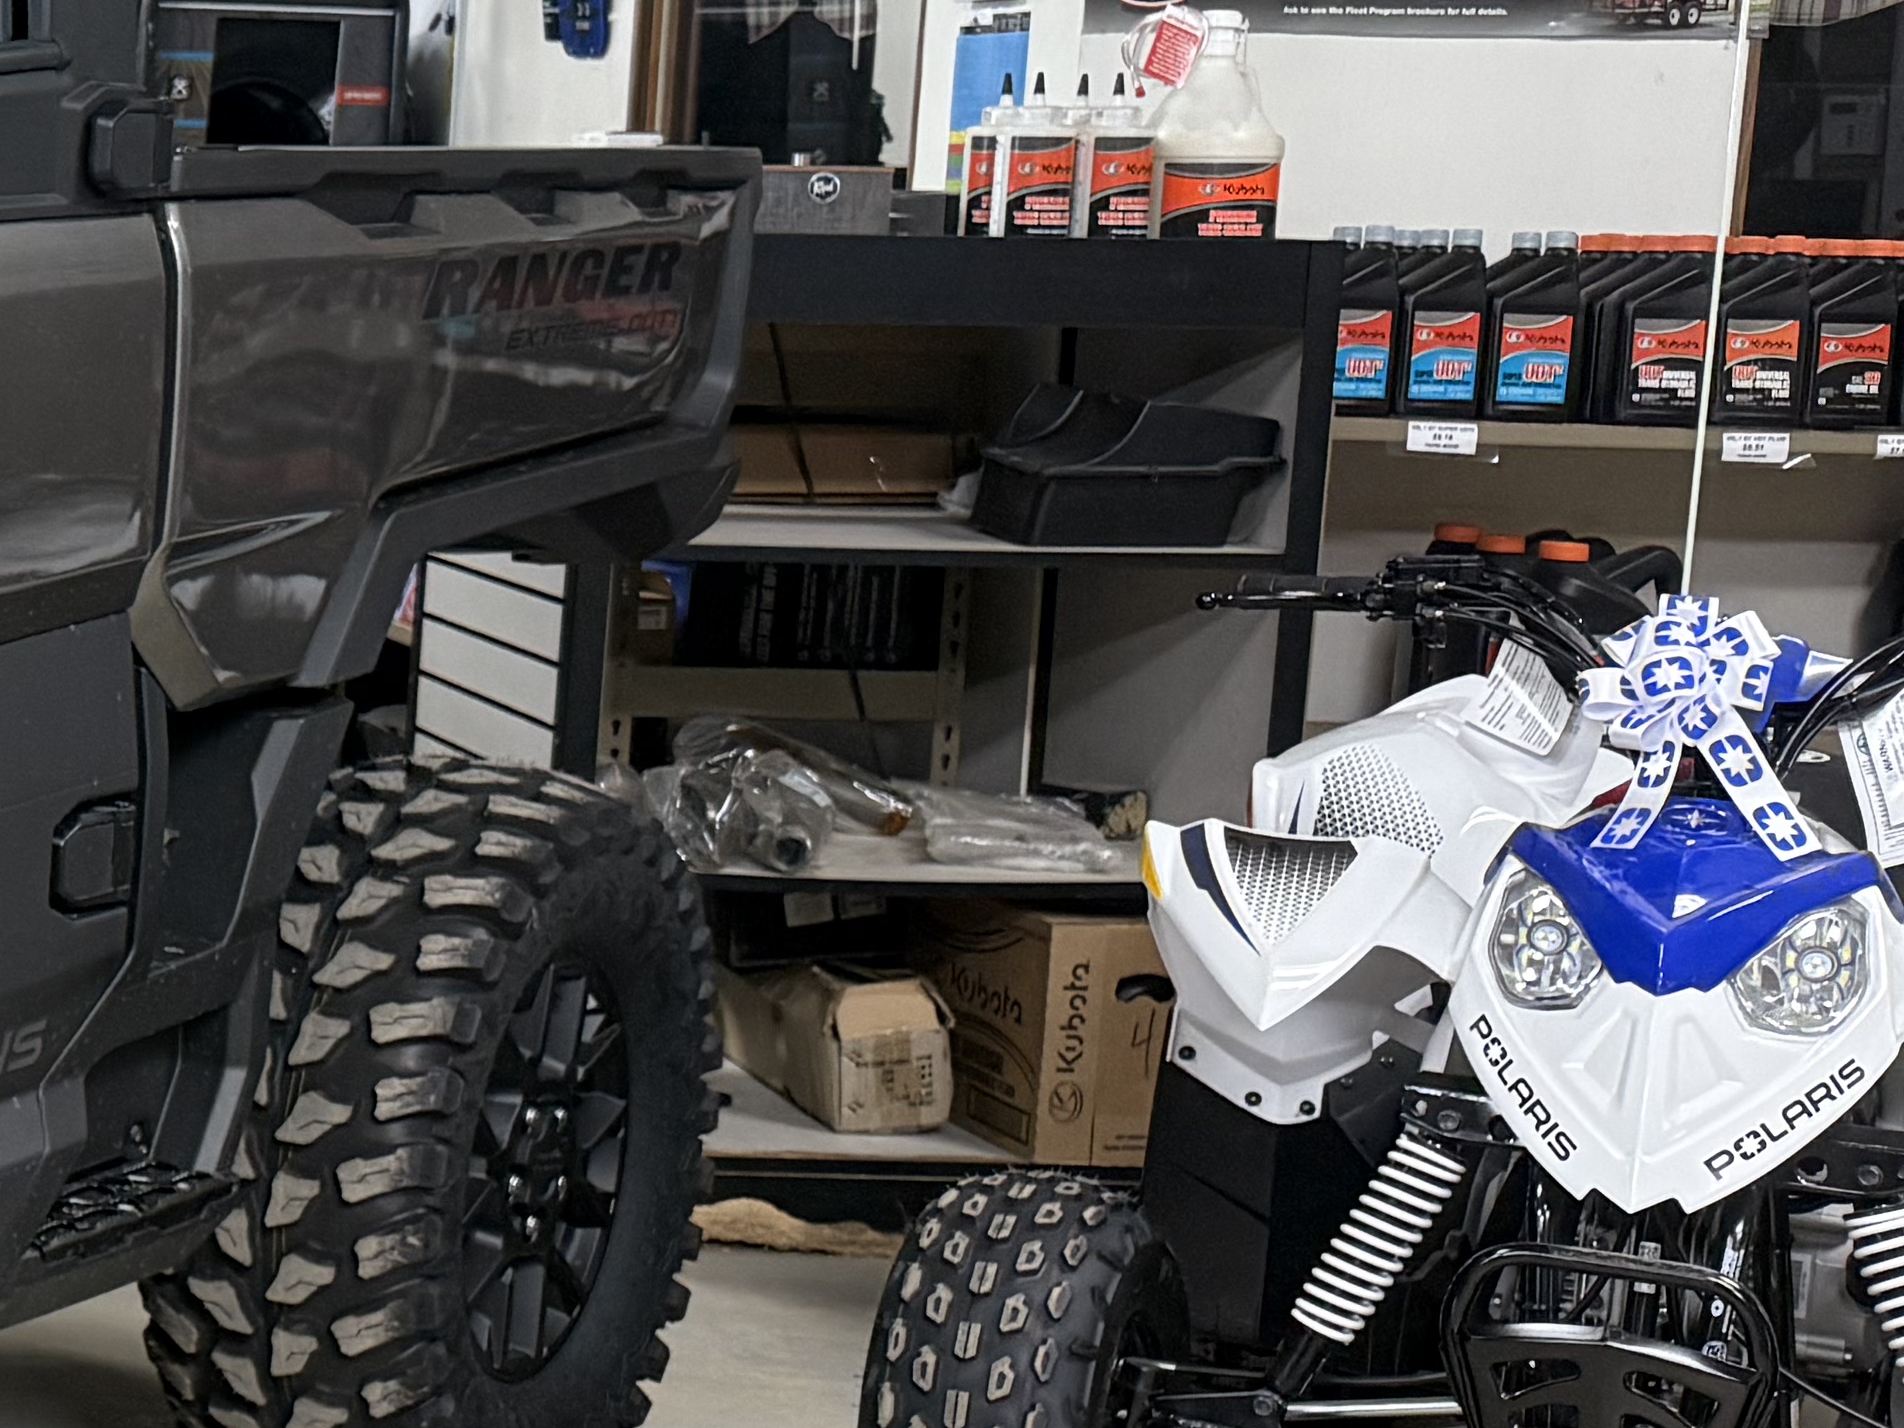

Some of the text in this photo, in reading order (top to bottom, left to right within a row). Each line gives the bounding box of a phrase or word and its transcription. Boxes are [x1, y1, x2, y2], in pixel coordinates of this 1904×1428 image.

[422, 242, 682, 320] RANGER
[1055, 958, 1091, 1073] Kubota
[1131, 1007, 1156, 1079] 4
[1468, 1013, 1578, 1163] POLARIS
[1703, 1058, 1866, 1181] POLARIS
